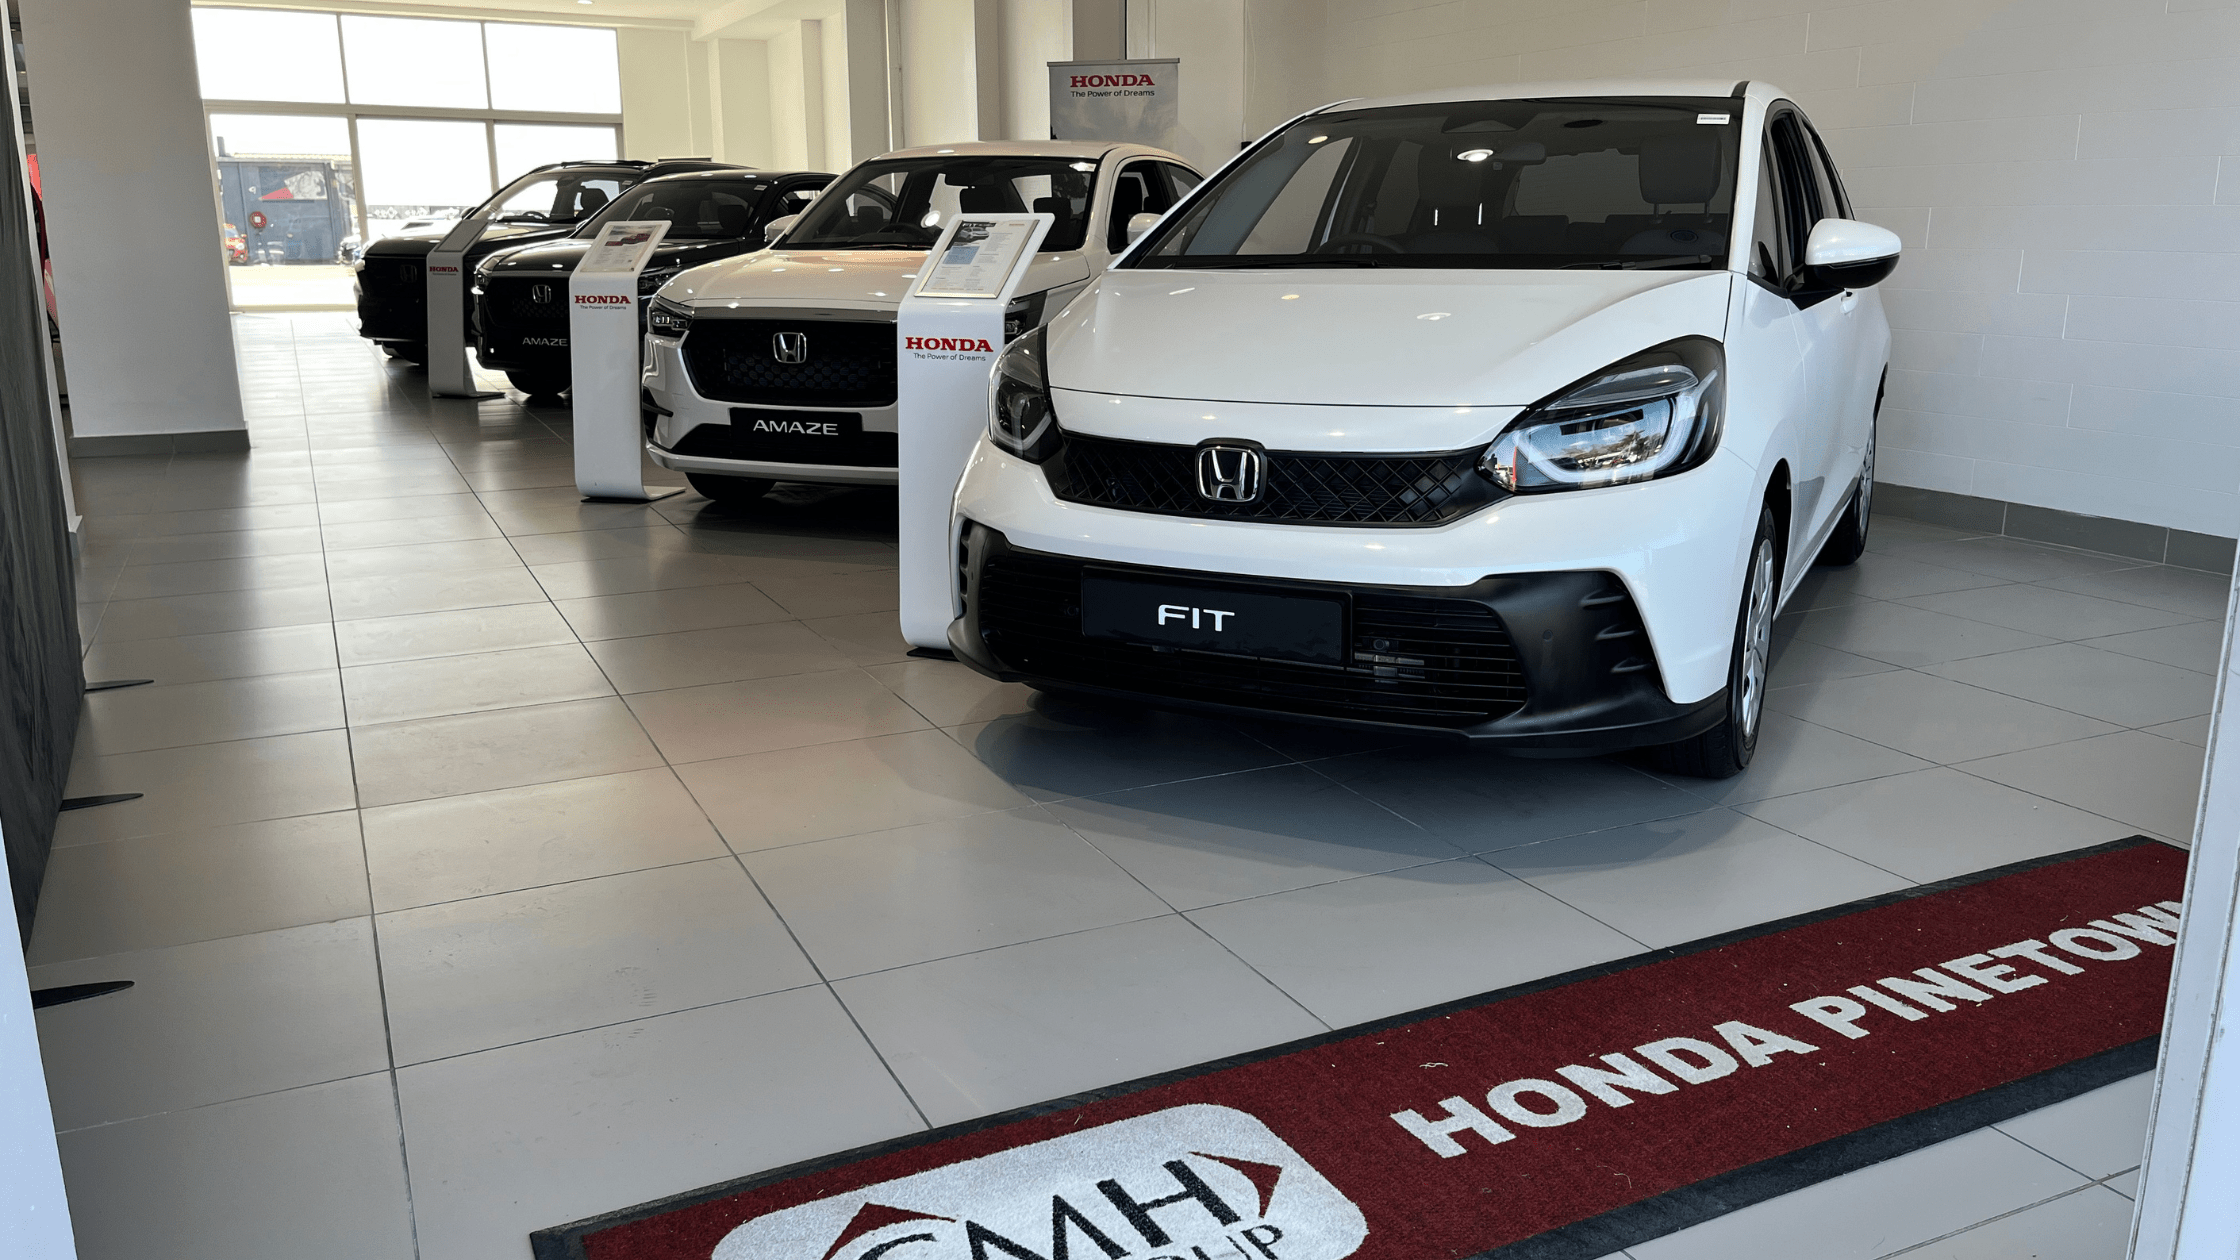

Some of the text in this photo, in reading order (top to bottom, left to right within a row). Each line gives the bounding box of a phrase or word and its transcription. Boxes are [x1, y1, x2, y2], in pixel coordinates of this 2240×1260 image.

[1070, 74, 1155, 88] HONDA
[1071, 89, 1155, 98] The Power of Dreams
[574, 295, 632, 305] HONDA
[522, 337, 568, 347] AMAZE
[905, 336, 994, 353] HONDA
[913, 352, 926, 360] The
[753, 419, 839, 436] AMAZE
[1158, 604, 1235, 632] FIT
[1389, 900, 2183, 1159] HONDA PINETOW
